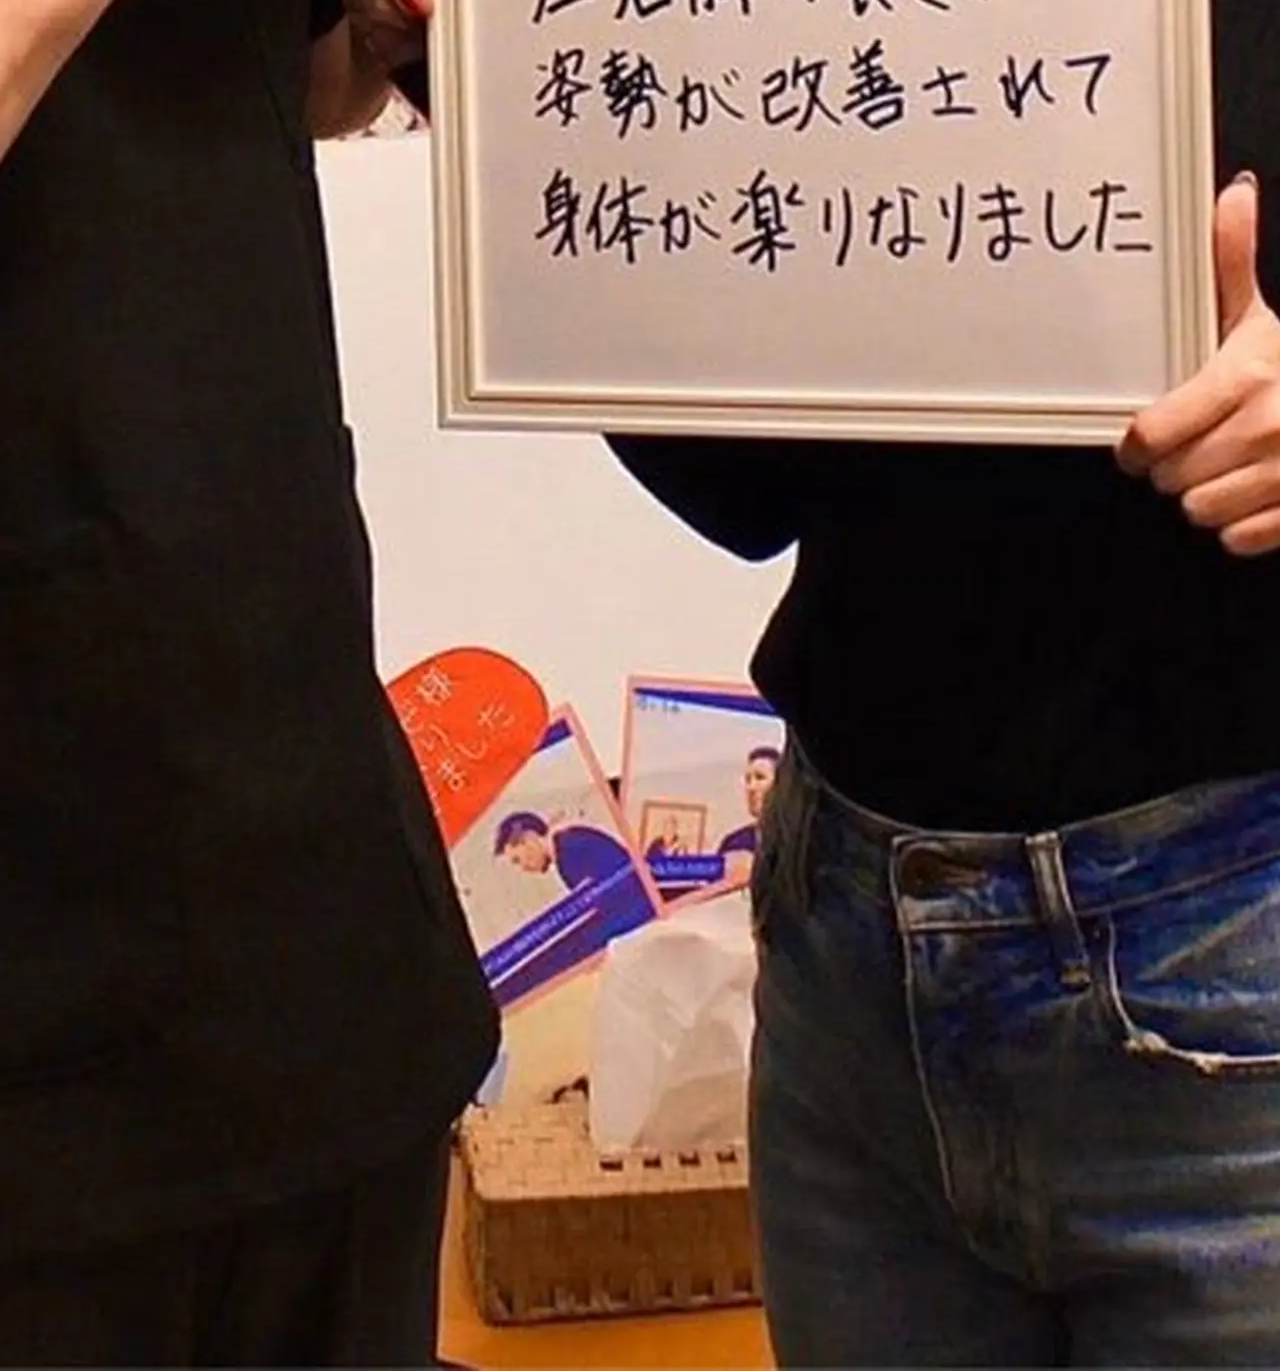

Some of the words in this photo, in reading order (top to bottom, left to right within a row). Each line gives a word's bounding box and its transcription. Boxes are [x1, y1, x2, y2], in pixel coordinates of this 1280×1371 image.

[534, 38, 1111, 139] 姿勢が改善されて
